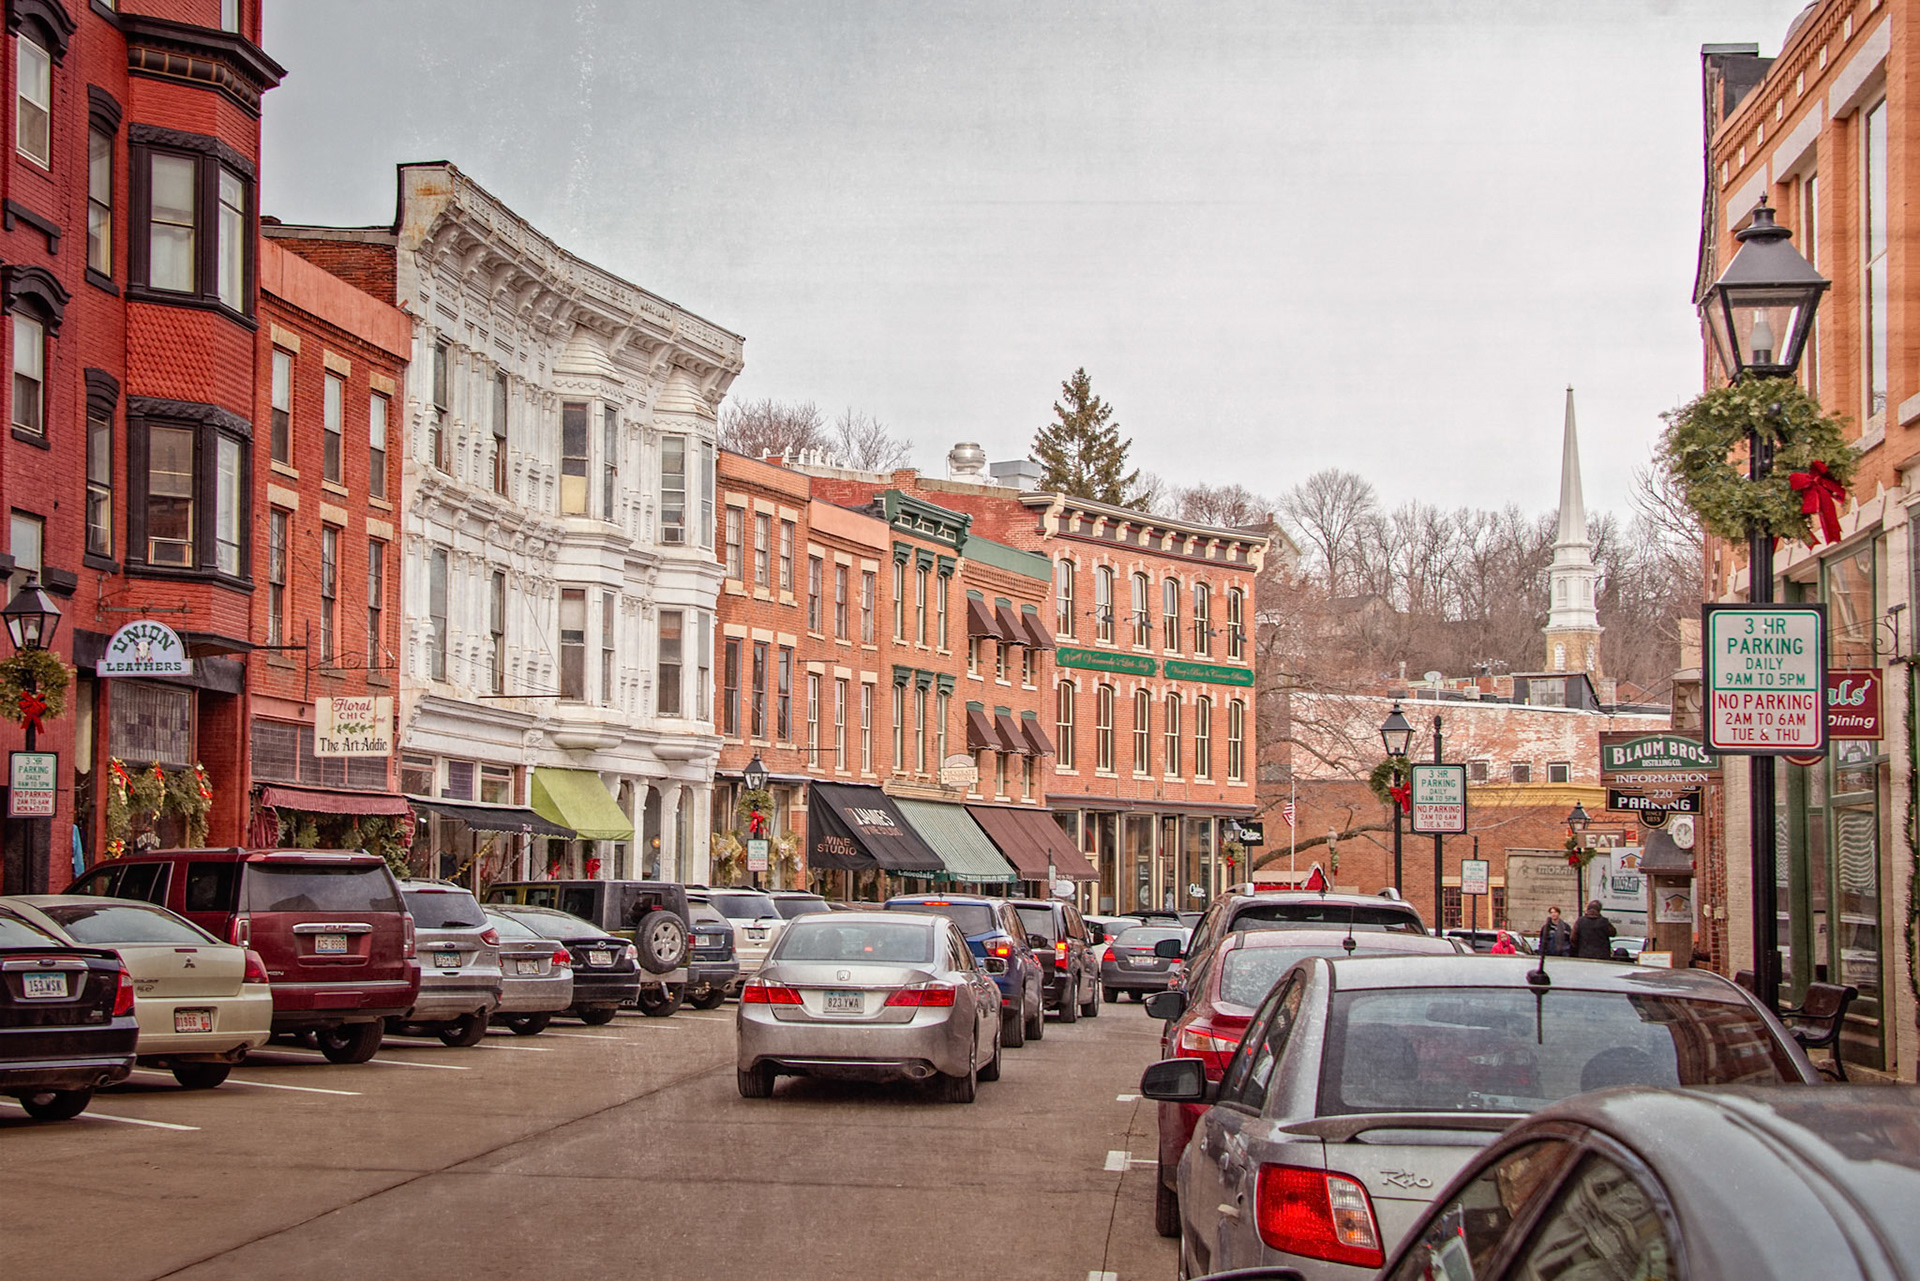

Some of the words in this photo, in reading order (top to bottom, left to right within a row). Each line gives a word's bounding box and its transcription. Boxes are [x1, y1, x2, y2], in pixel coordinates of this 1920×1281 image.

[1745, 618, 1754, 634] 3
[1764, 618, 1786, 634] HR
[112, 624, 175, 654] UNION
[1727, 638, 1803, 655] PARKING
[106, 662, 182, 672] LEATHERS
[1746, 658, 1784, 670] DAILY
[1725, 672, 1753, 684] 9AM
[1758, 673, 1774, 685] TO
[1779, 673, 1805, 686] 5PM
[332, 698, 372, 712] Floral
[1718, 694, 1738, 709] NO
[1744, 694, 1813, 710] PARKING
[339, 712, 366, 720] CHIC
[1725, 712, 1752, 725] 2AM
[1758, 713, 1773, 725] TO
[1778, 713, 1806, 726] 6AM
[1828, 715, 1875, 729] Dining
[1731, 728, 1755, 740] TUE
[1760, 728, 1769, 741] &
[1776, 728, 1800, 741] THU
[320, 738, 339, 752] The
[342, 737, 359, 751] Art
[1612, 741, 1665, 765] BLAUM
[1669, 741, 1712, 764] BROS.
[26, 757, 31, 765] 3
[1642, 758, 1671, 767] DISTILLING
[18, 766, 49, 774] PARKING
[1429, 770, 1435, 778] 3
[1438, 770, 1449, 778] HR
[1421, 779, 1456, 787] PARKING
[1615, 773, 1709, 784] INFORMATION
[1653, 789, 1673, 799] 220
[1417, 805, 1427, 813] NO
[1428, 805, 1460, 813] PARKING
[1618, 797, 1690, 811] PARNG
[137, 832, 161, 848] UNION
[824, 835, 851, 847] WINE
[1586, 834, 1620, 848] EAT
[817, 843, 857, 856] STUDIO
[29, 980, 44, 992] 153
[827, 998, 842, 1008] 823
[844, 997, 859, 1008] YWA
[1380, 1168, 1433, 1189] Rio
